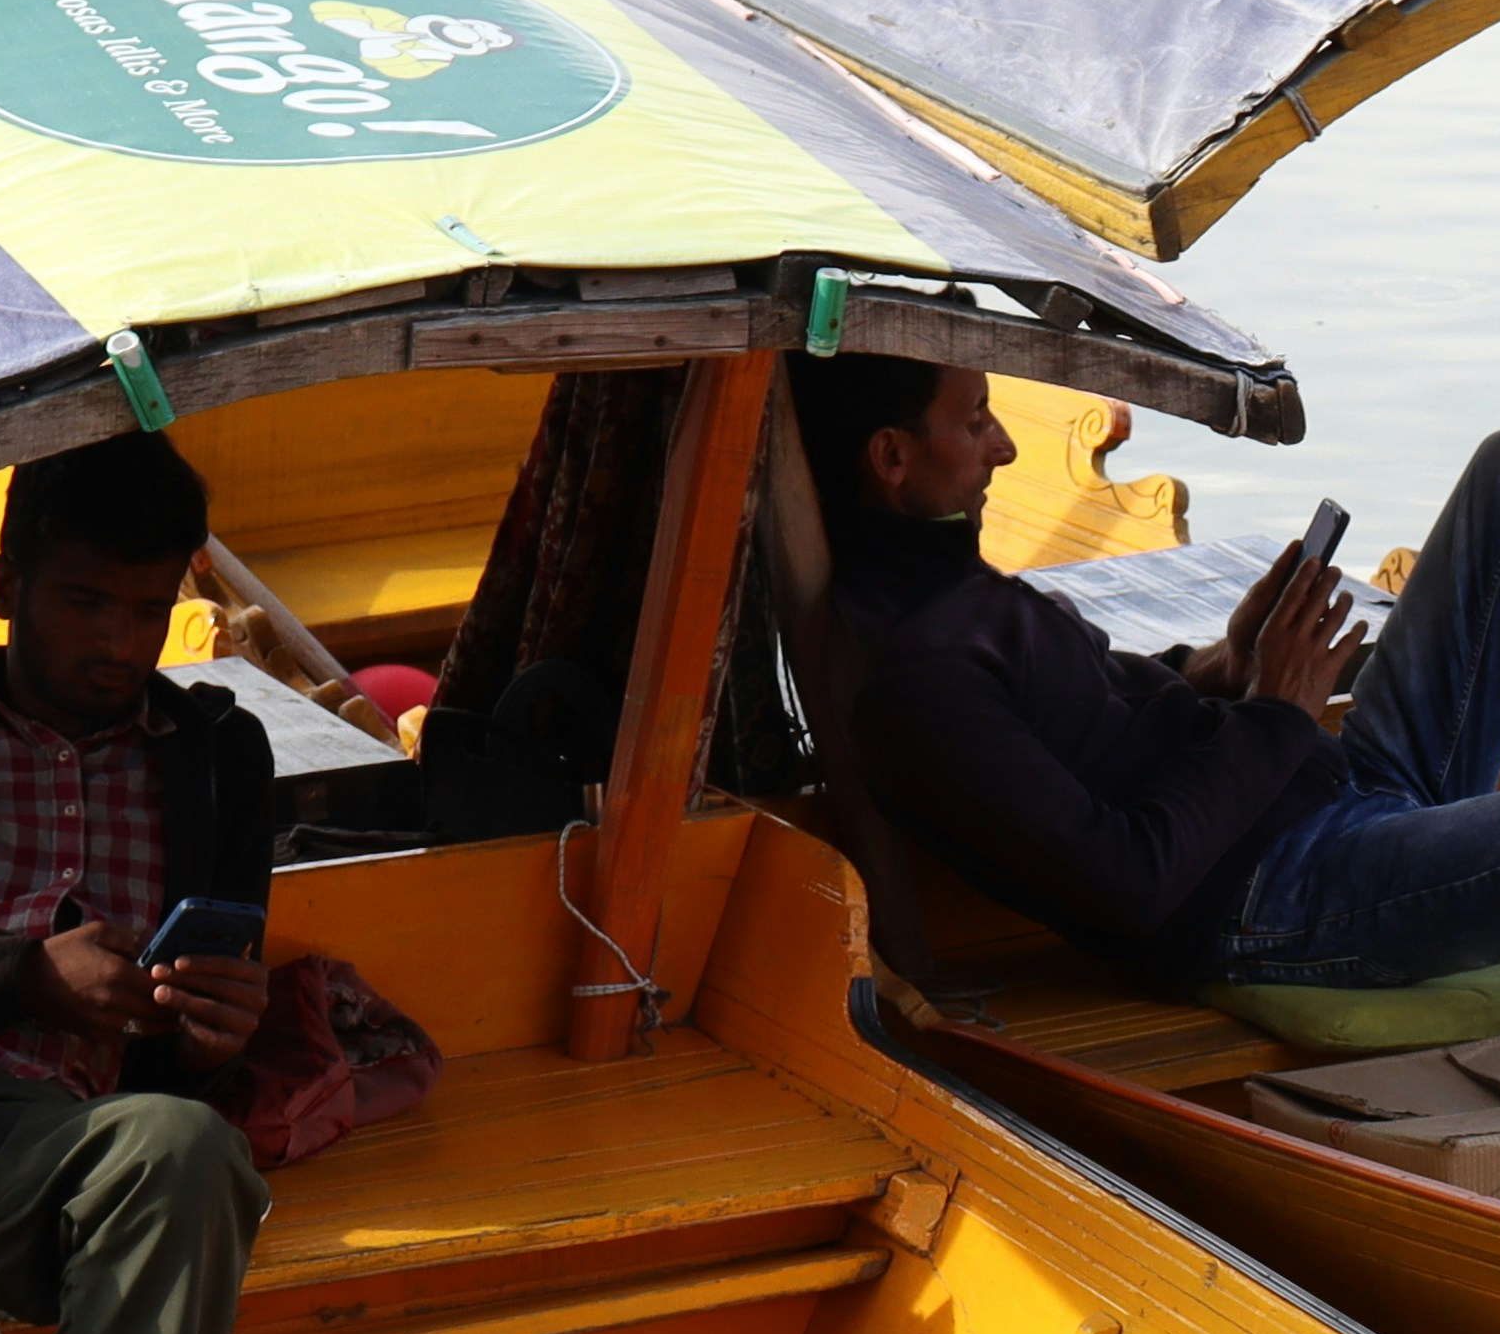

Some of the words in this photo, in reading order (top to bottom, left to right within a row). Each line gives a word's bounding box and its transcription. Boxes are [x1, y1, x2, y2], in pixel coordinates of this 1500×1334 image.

[97, 36, 167, 76] Idlis
[144, 79, 189, 95] &
[162, 98, 235, 144] More
